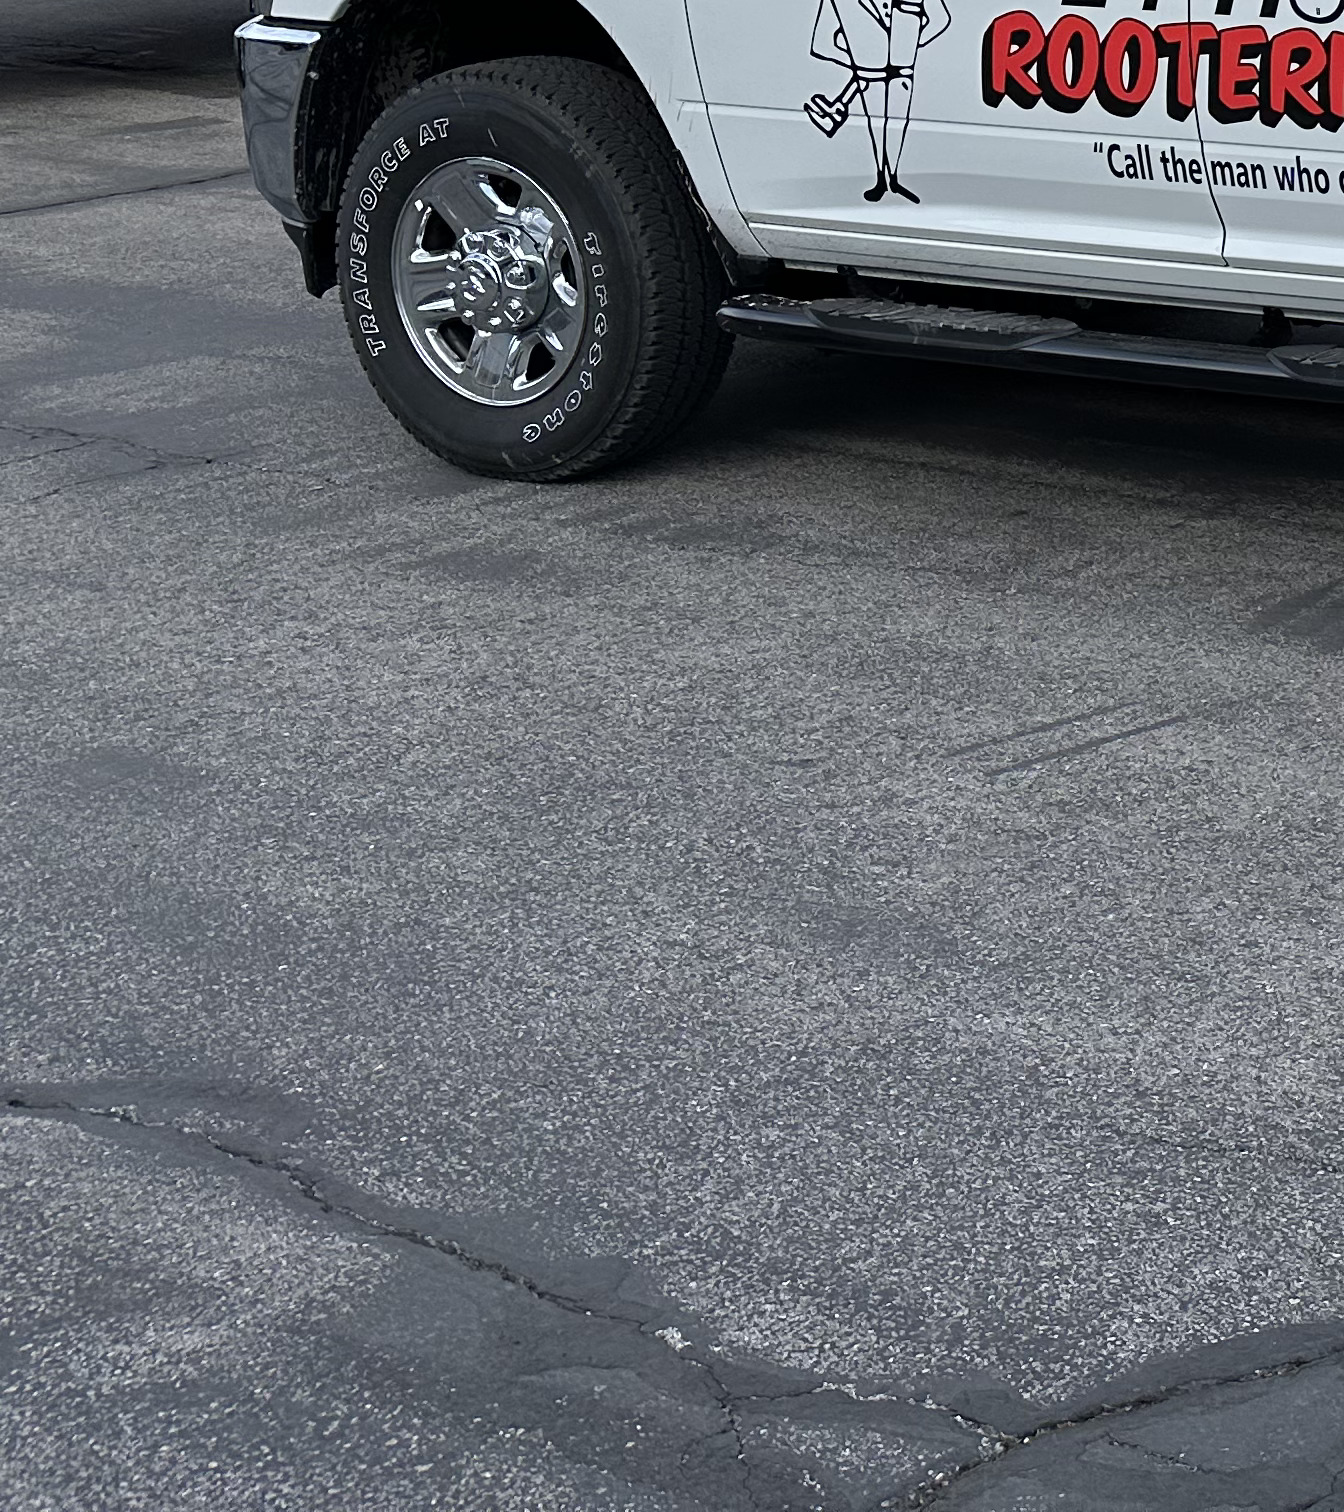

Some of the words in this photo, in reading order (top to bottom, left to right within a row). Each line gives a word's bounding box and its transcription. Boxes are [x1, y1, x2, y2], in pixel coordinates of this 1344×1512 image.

[350, 136, 411, 357] TRANSFORCE
[419, 118, 450, 147] AT
[1159, 146, 1203, 185] the
[1210, 160, 1268, 190] man
[1273, 155, 1330, 195] who
